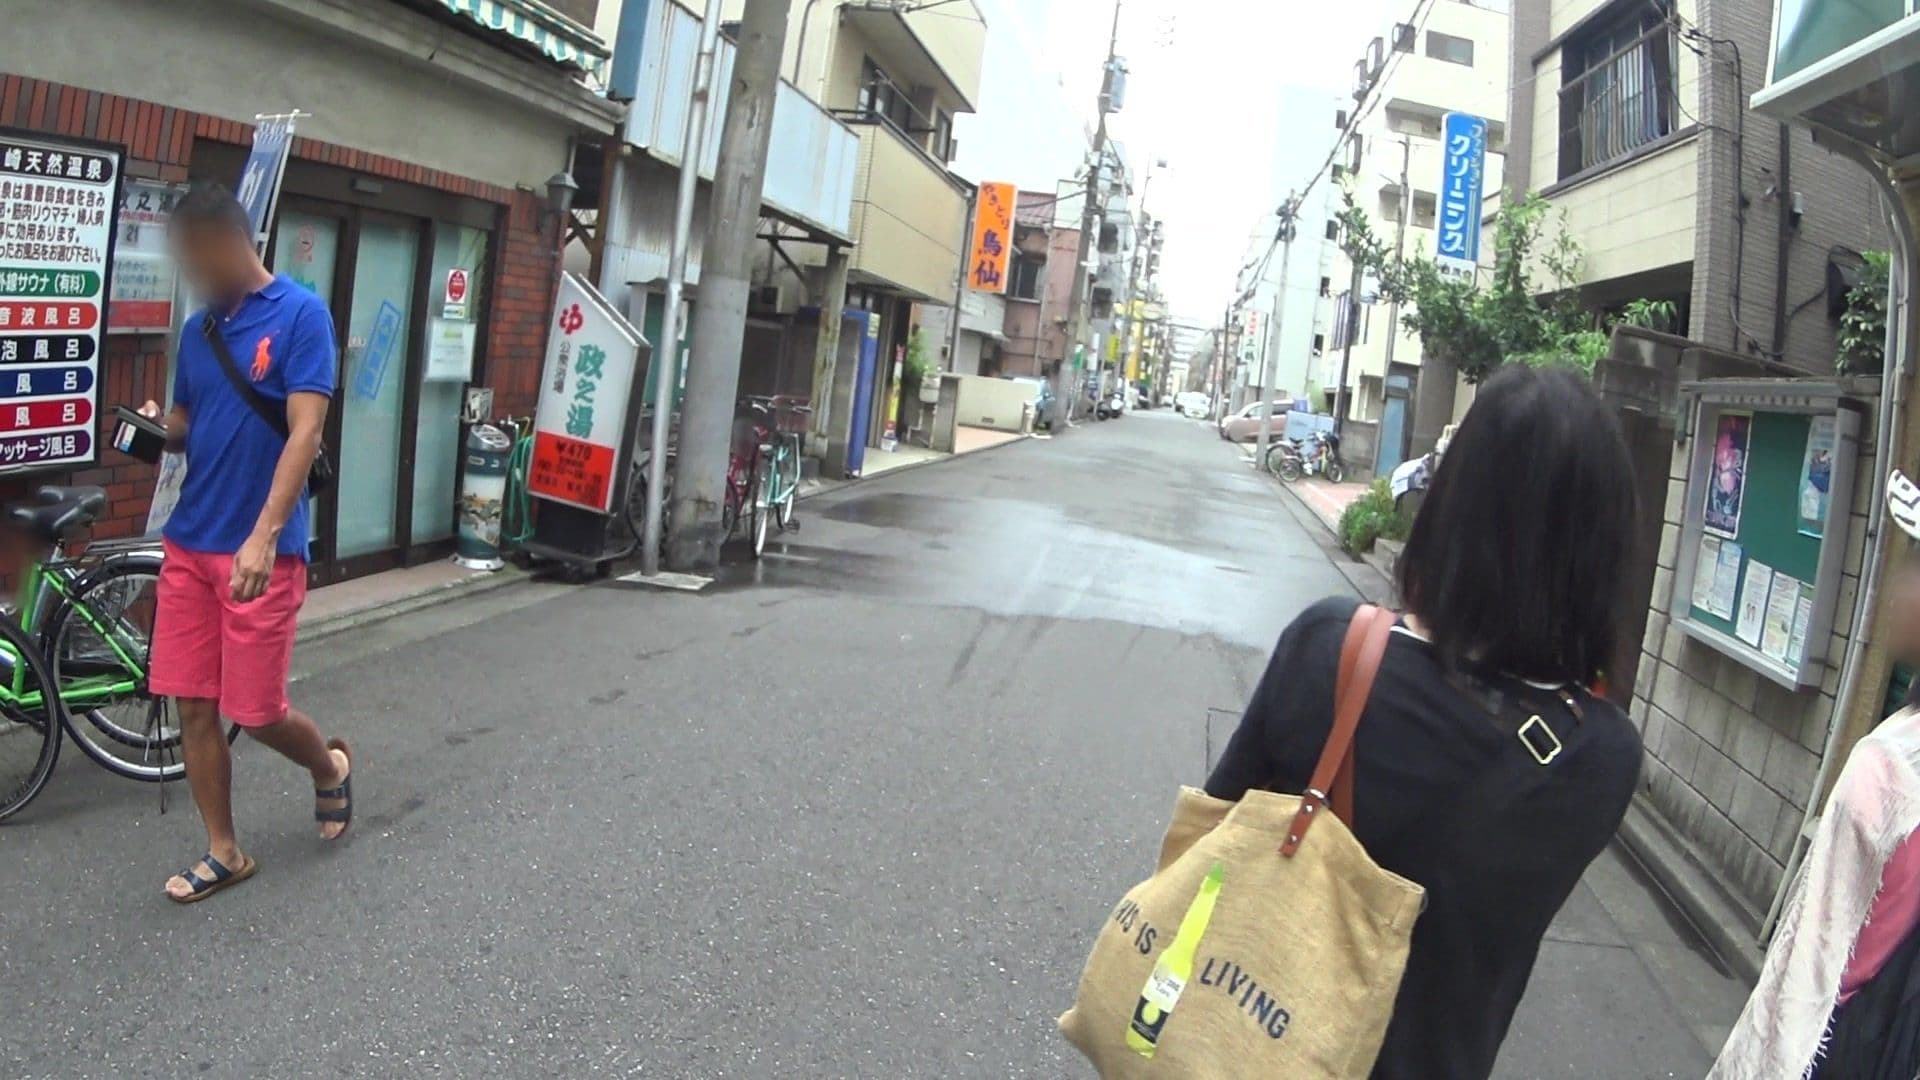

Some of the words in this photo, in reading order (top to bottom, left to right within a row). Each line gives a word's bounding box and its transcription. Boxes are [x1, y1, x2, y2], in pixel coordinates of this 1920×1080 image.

[4, 147, 102, 180] 崎天然温泉
[983, 184, 1010, 230] やきとり
[1441, 134, 1471, 252] クリーニング
[976, 228, 1003, 286] 鳥仙
[559, 303, 584, 335] ゆ
[1, 338, 80, 361] 泡風呂
[16, 370, 78, 394] 風呂
[565, 344, 607, 440] 政之湯
[15, 402, 77, 428] 風呂
[1133, 920, 1158, 955] IS
[1199, 957, 1291, 1040] LIVING
